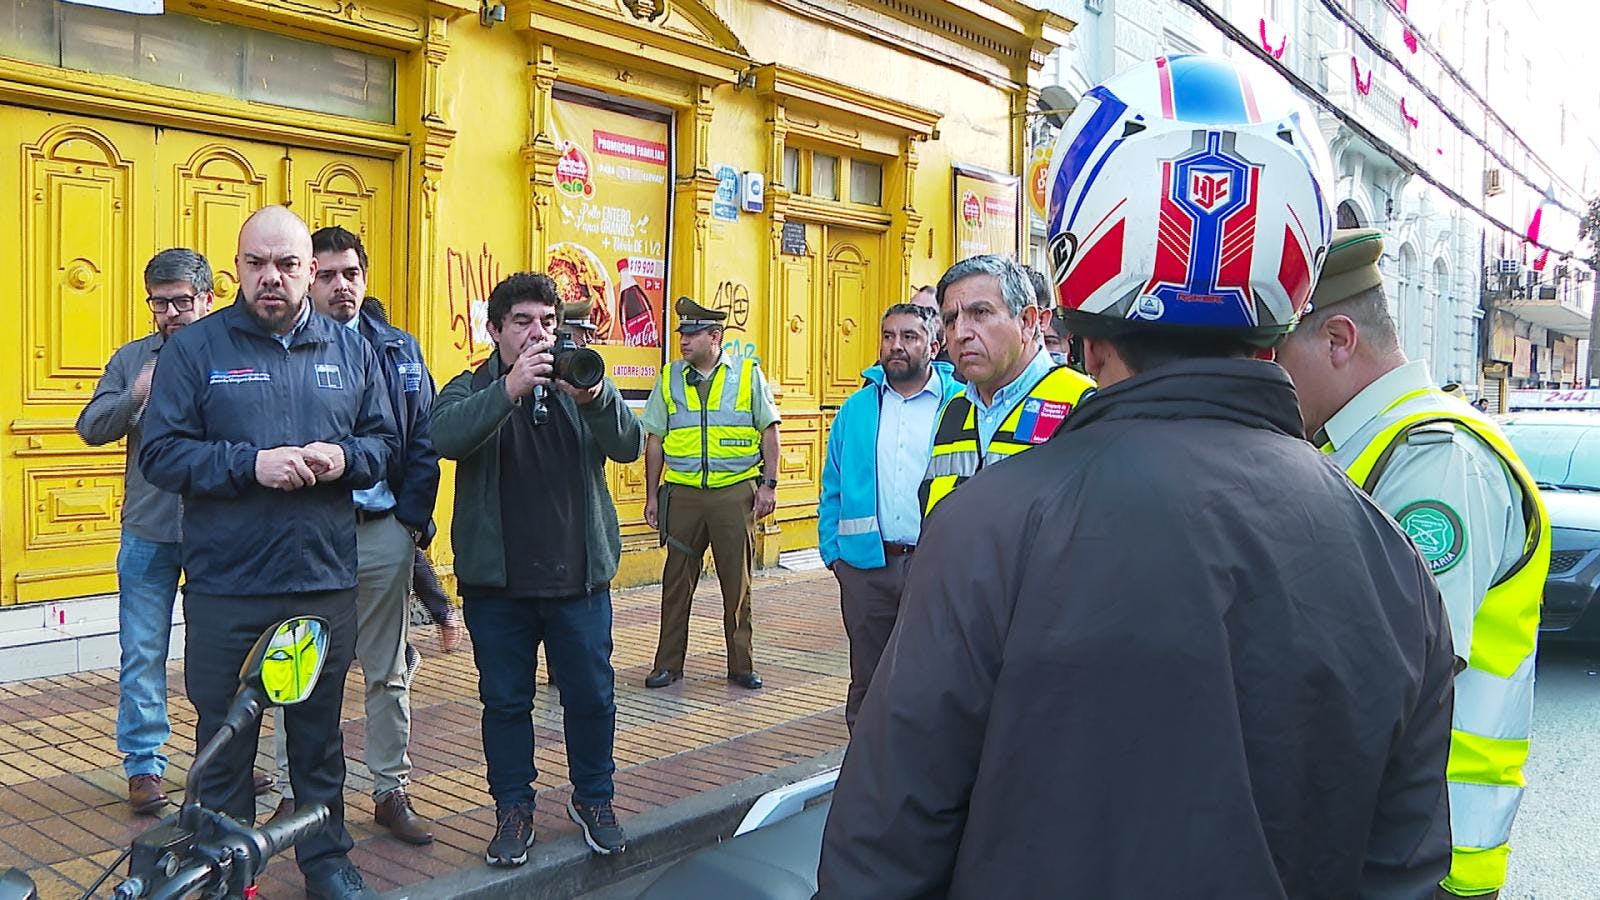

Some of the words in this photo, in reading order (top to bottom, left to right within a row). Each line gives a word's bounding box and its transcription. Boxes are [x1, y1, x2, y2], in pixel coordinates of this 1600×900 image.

[636, 146, 665, 162] FAMILIAR
[602, 206, 631, 223] ENTERO
[601, 219, 635, 238] GRANDES
[613, 366, 639, 377] LATORRE
[1544, 391, 1588, 403] 244
